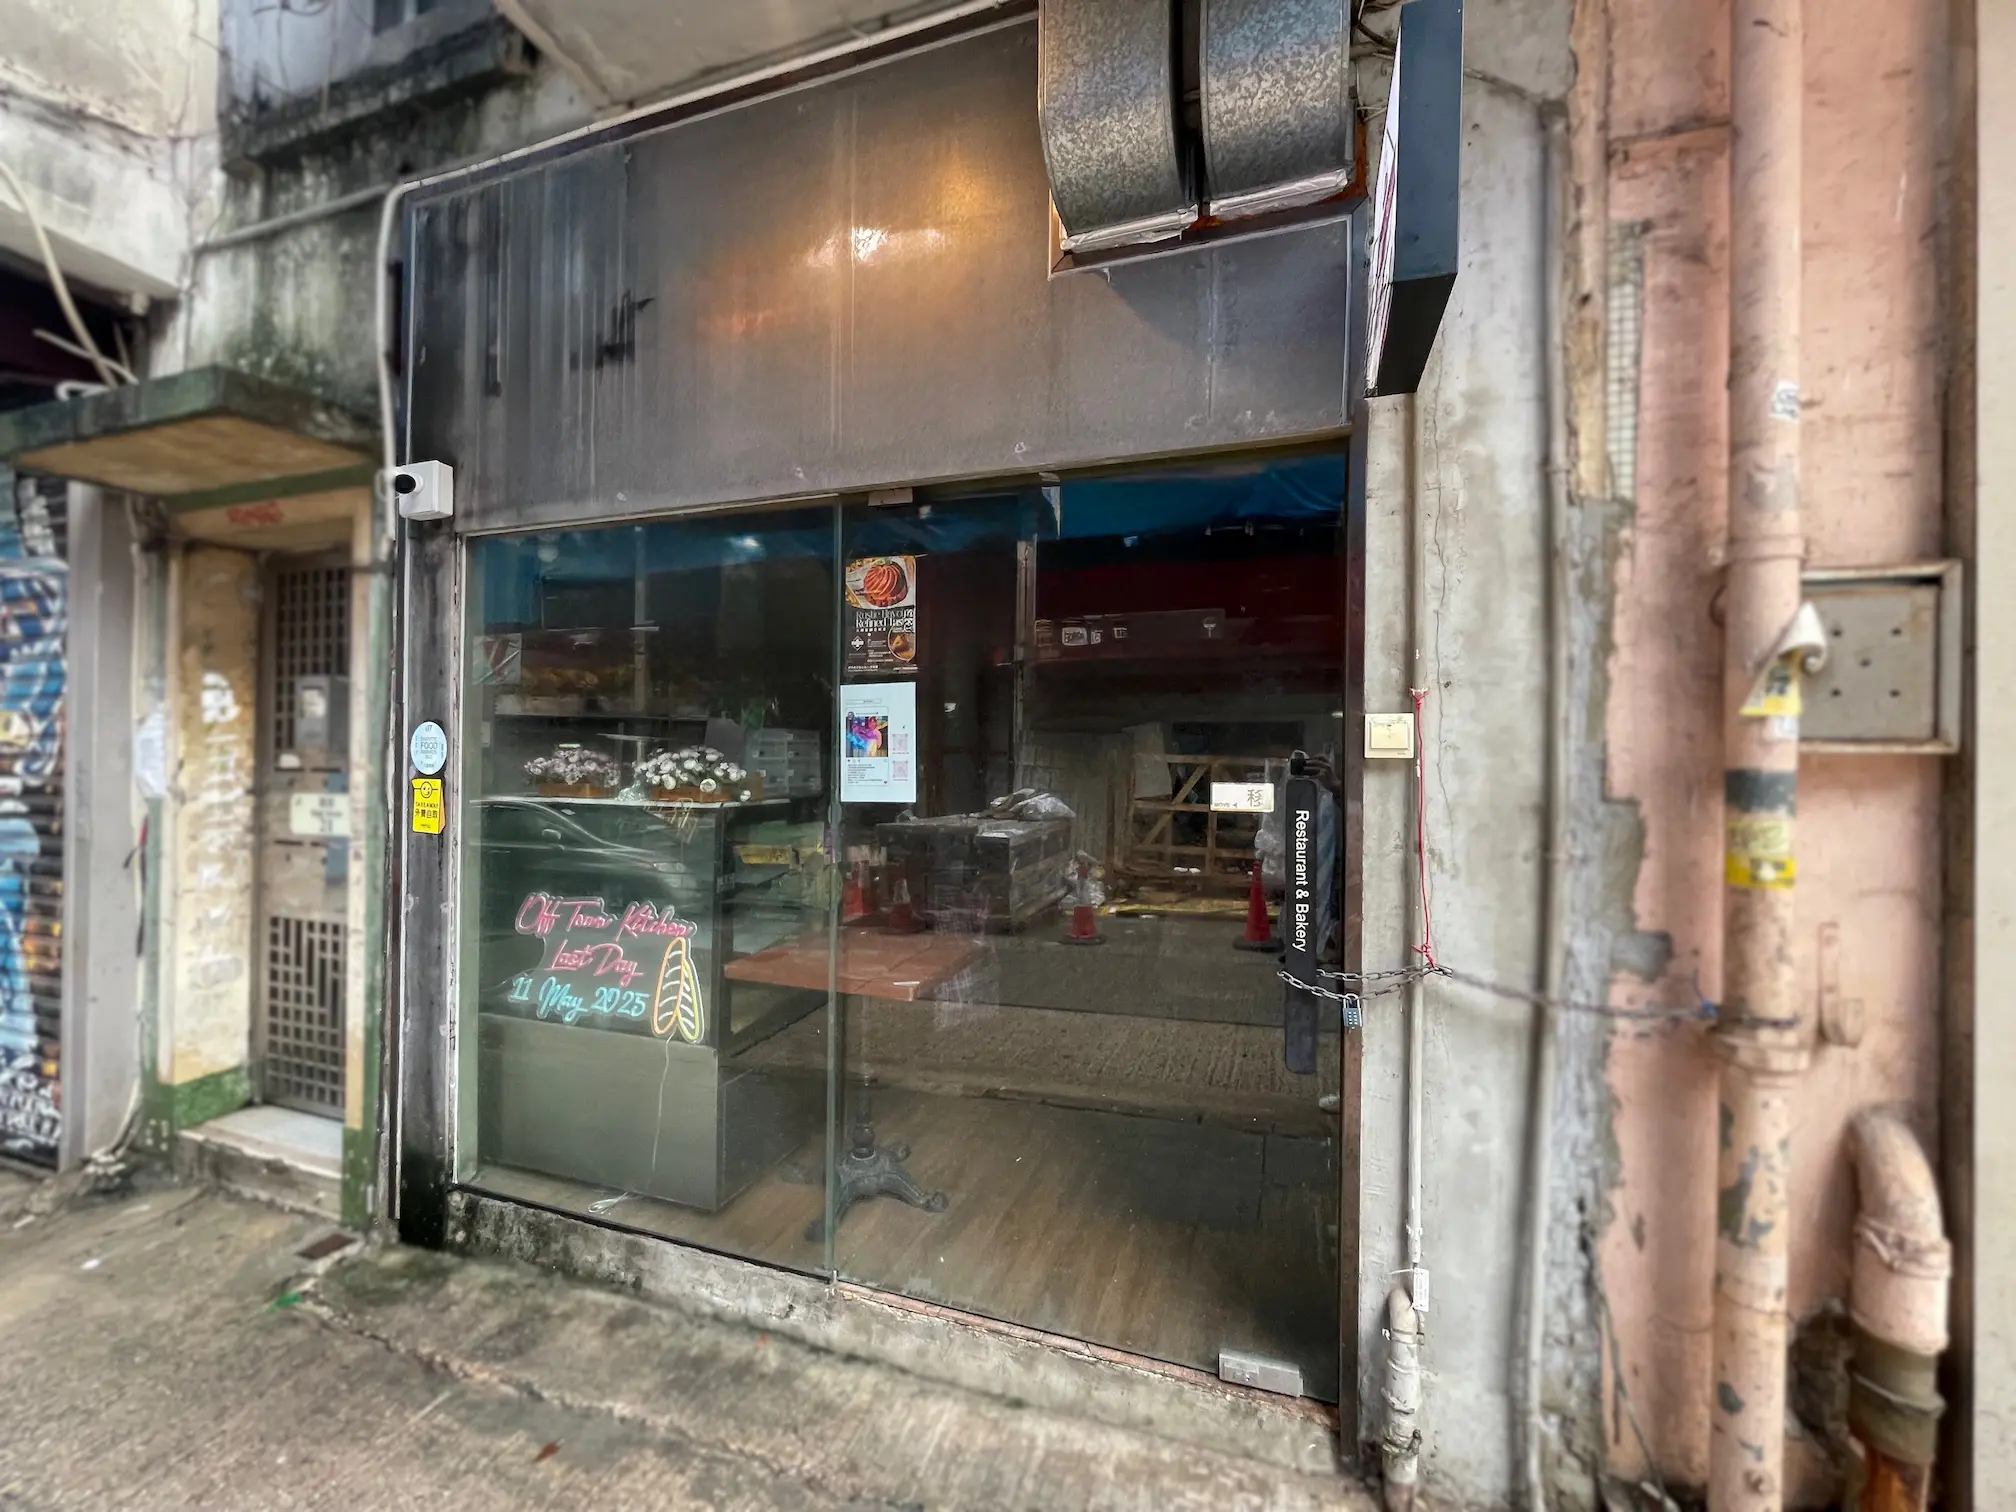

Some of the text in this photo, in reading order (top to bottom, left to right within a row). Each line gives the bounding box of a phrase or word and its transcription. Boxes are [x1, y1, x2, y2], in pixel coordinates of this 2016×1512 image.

[1292, 809, 1310, 952] Restaurant & Bakery
[515, 894, 561, 933] Off
[615, 904, 695, 942] Kitchen
[544, 938, 645, 987] Last Day
[509, 976, 650, 1023] 11 May 2025
